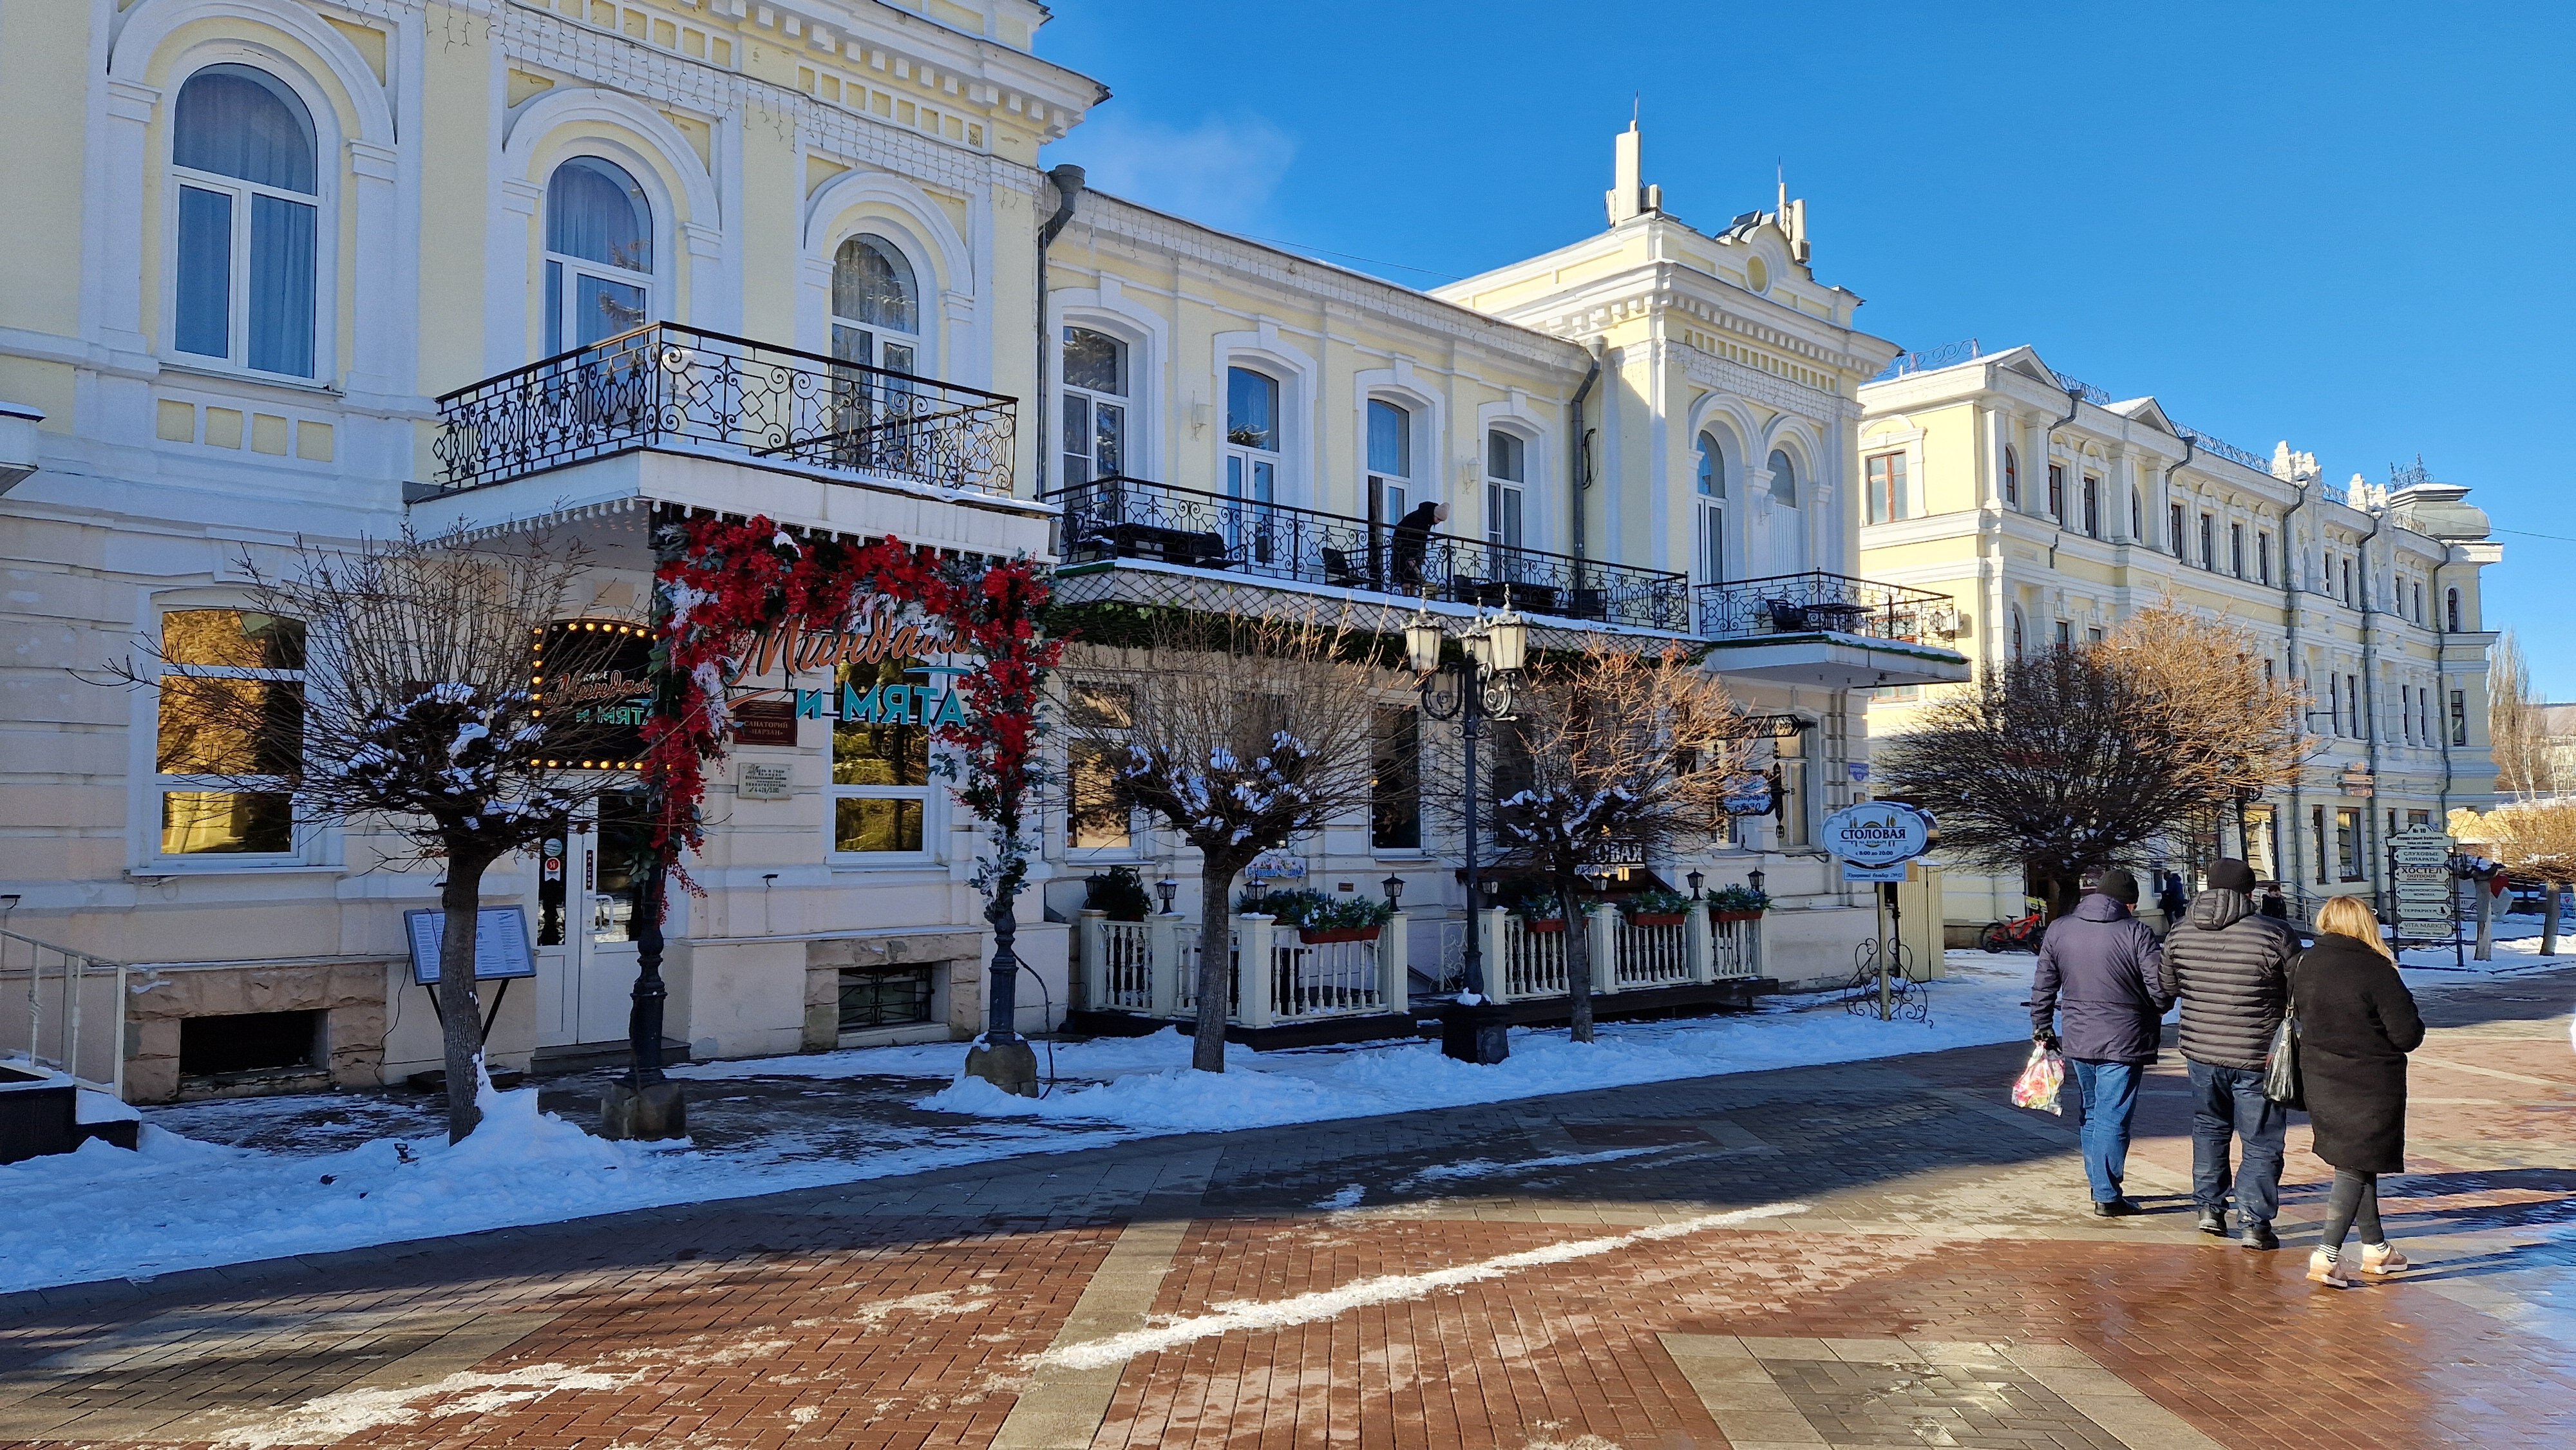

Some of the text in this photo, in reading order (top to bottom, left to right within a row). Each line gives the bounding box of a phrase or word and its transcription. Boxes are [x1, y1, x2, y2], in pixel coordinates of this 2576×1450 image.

[542, 670, 656, 707] Миндал
[842, 679, 968, 728] МЯТА
[743, 720, 788, 729] САНАТОРИЙ
[1841, 829, 1906, 840] СТОЛОВАЯ
